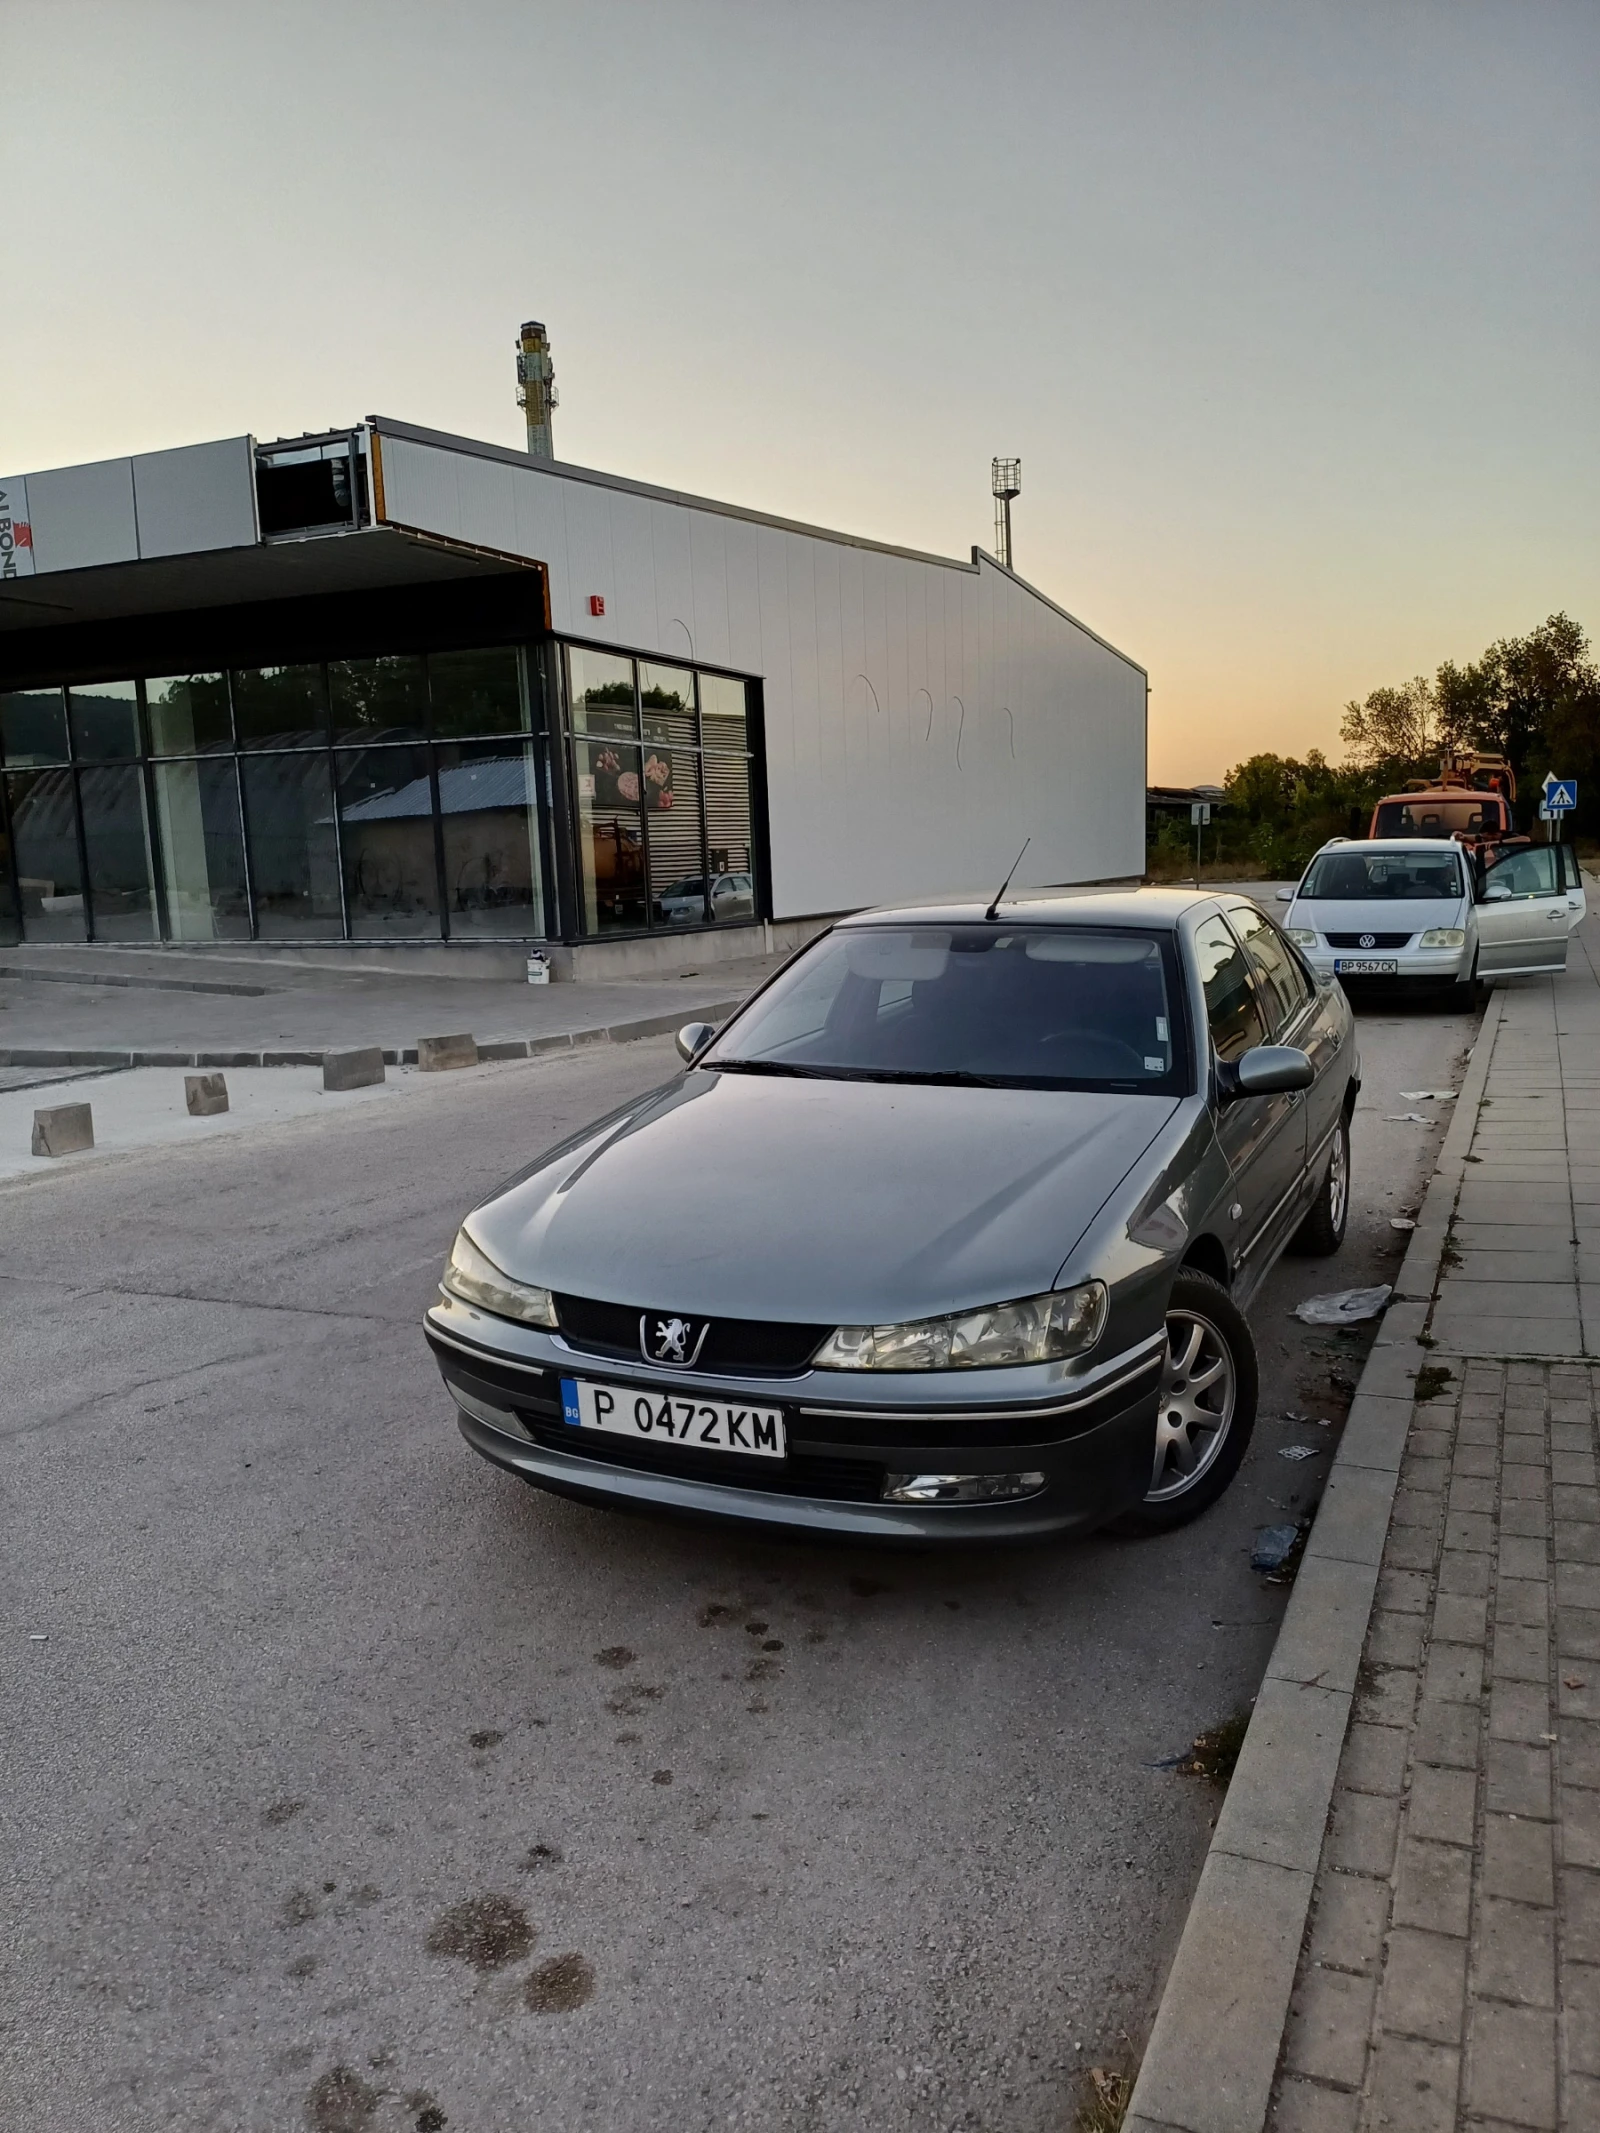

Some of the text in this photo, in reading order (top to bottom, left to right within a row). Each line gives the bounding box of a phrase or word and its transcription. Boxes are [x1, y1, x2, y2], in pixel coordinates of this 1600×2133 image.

[1341, 961, 1395, 972] BP 9567 CK
[565, 1406, 579, 1419] BG
[593, 1389, 615, 1425] P
